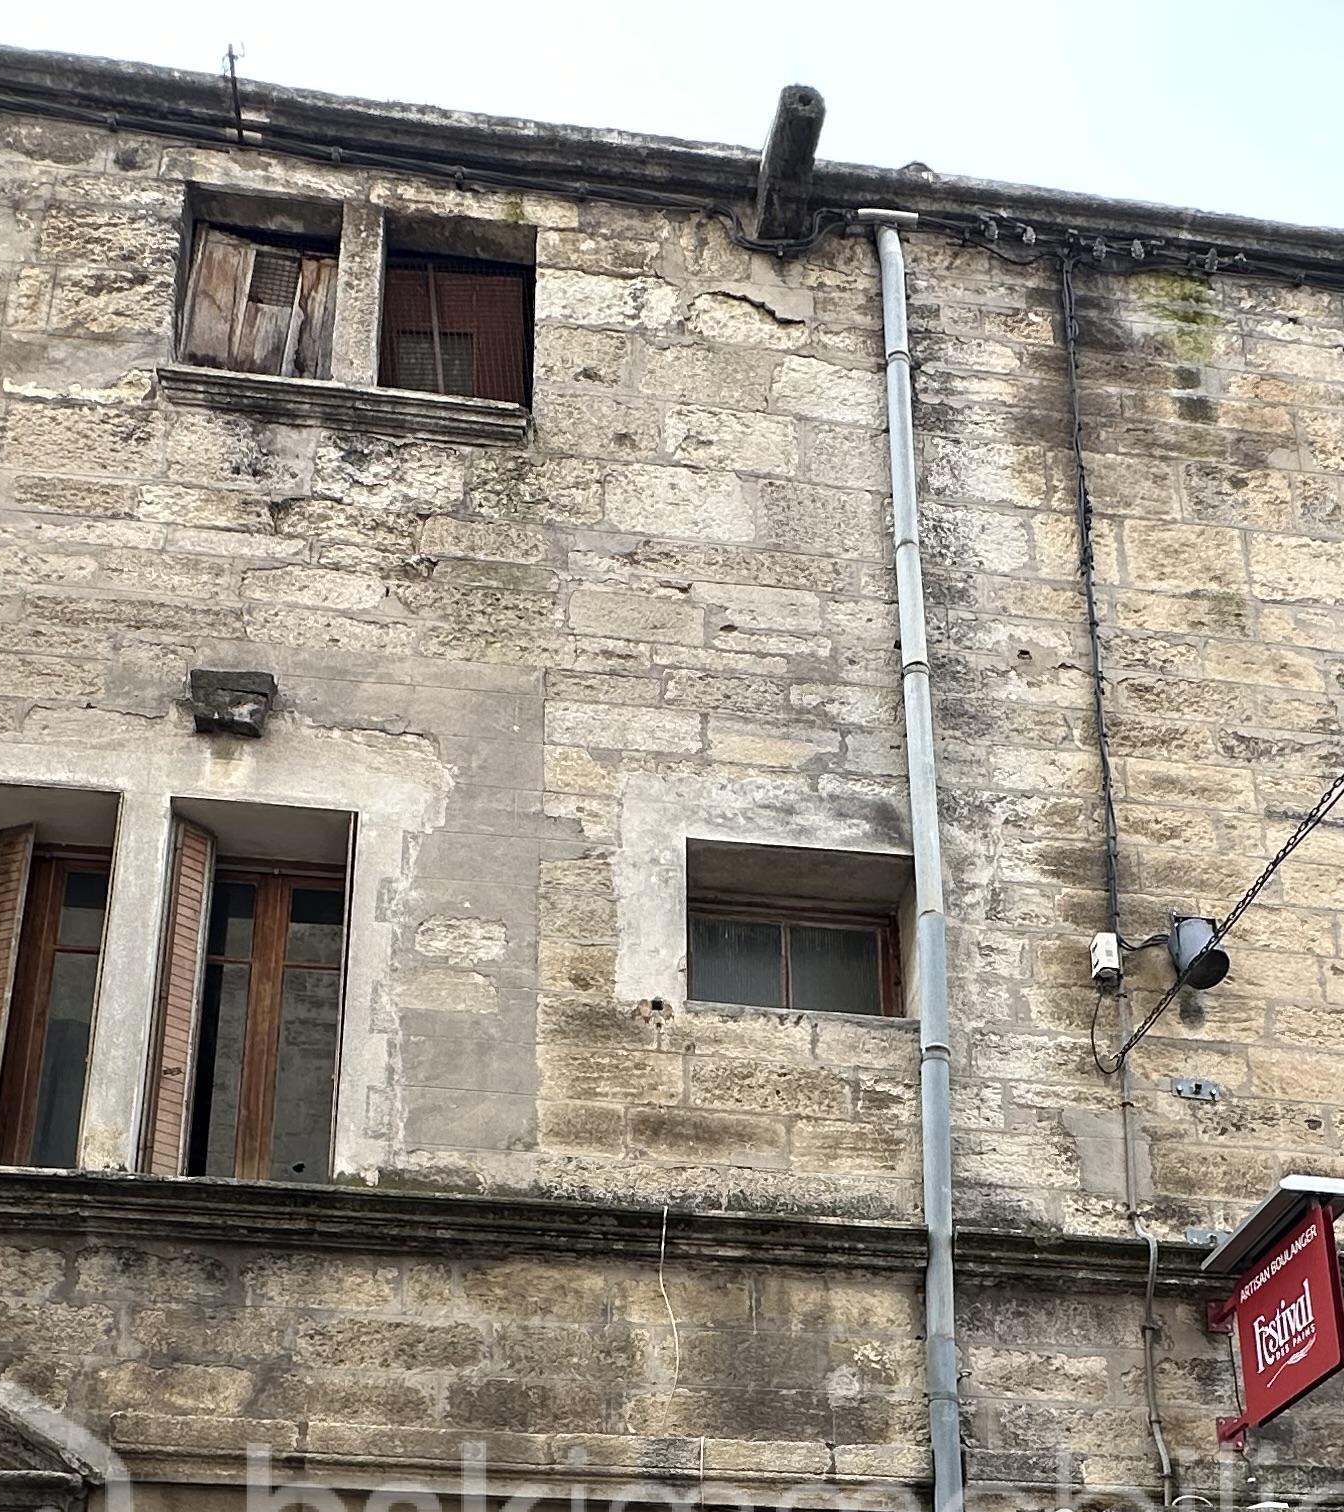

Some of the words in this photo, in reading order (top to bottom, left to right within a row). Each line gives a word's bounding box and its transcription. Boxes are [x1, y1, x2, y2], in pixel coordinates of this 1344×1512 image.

[1239, 1266, 1271, 1304] ARTISAN
[1270, 1224, 1318, 1275] BOULANGER
[1253, 1278, 1315, 1373] Festival
[1275, 1343, 1291, 1361] DES
[1292, 1323, 1317, 1348] PAINS
